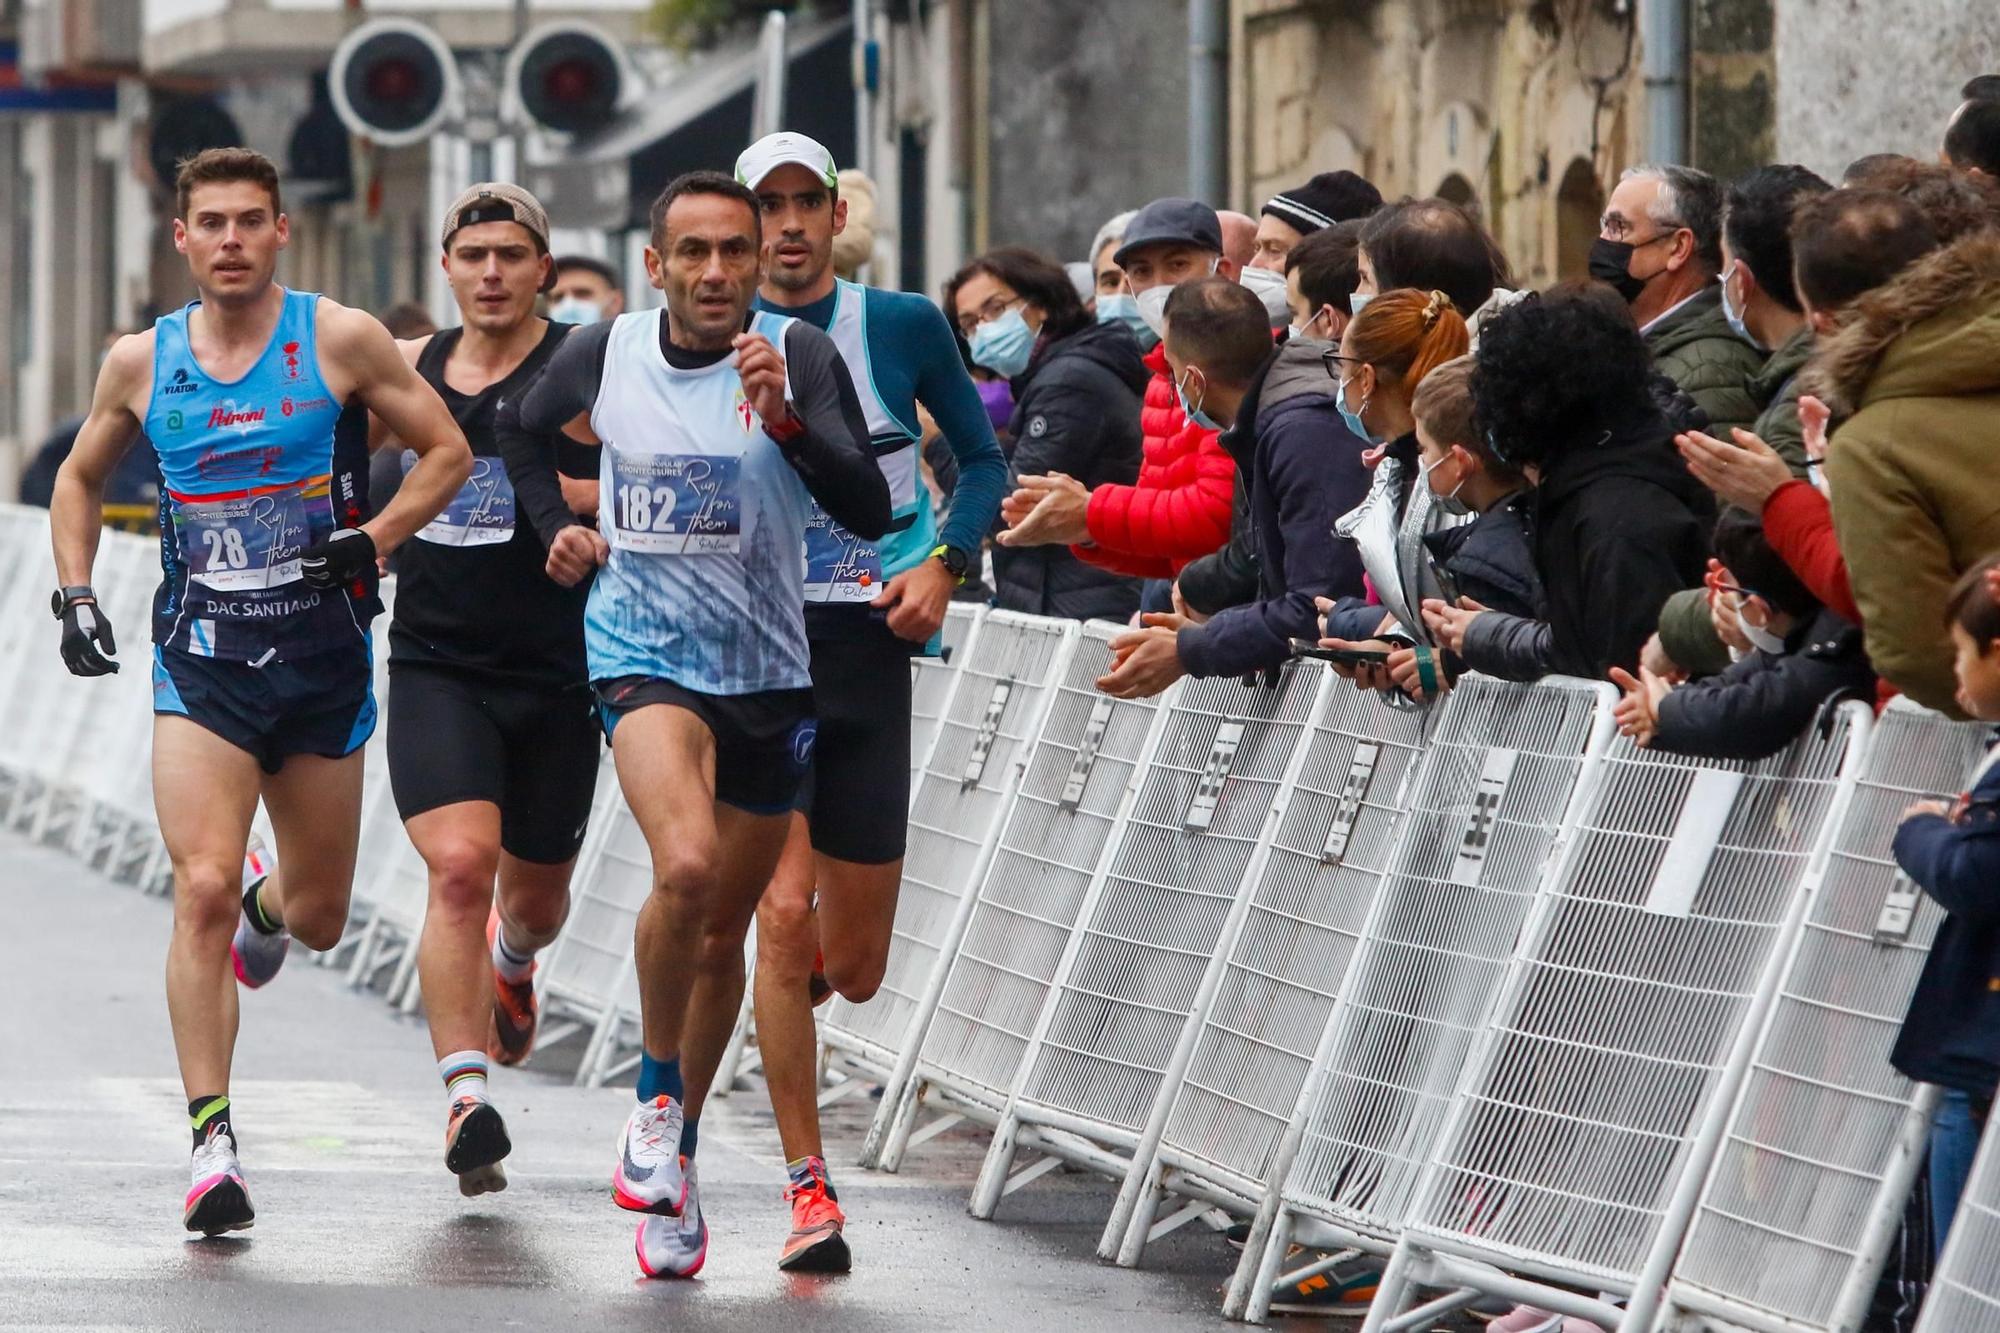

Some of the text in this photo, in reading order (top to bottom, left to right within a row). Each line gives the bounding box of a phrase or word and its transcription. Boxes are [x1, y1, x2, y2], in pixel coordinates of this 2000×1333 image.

[164, 384, 198, 395] VIATOR
[208, 408, 265, 428] Petroni
[340, 472, 354, 500] SAR
[618, 484, 677, 533] 182
[202, 527, 249, 571] 28
[207, 592, 321, 617] DAC SANTIAGO
